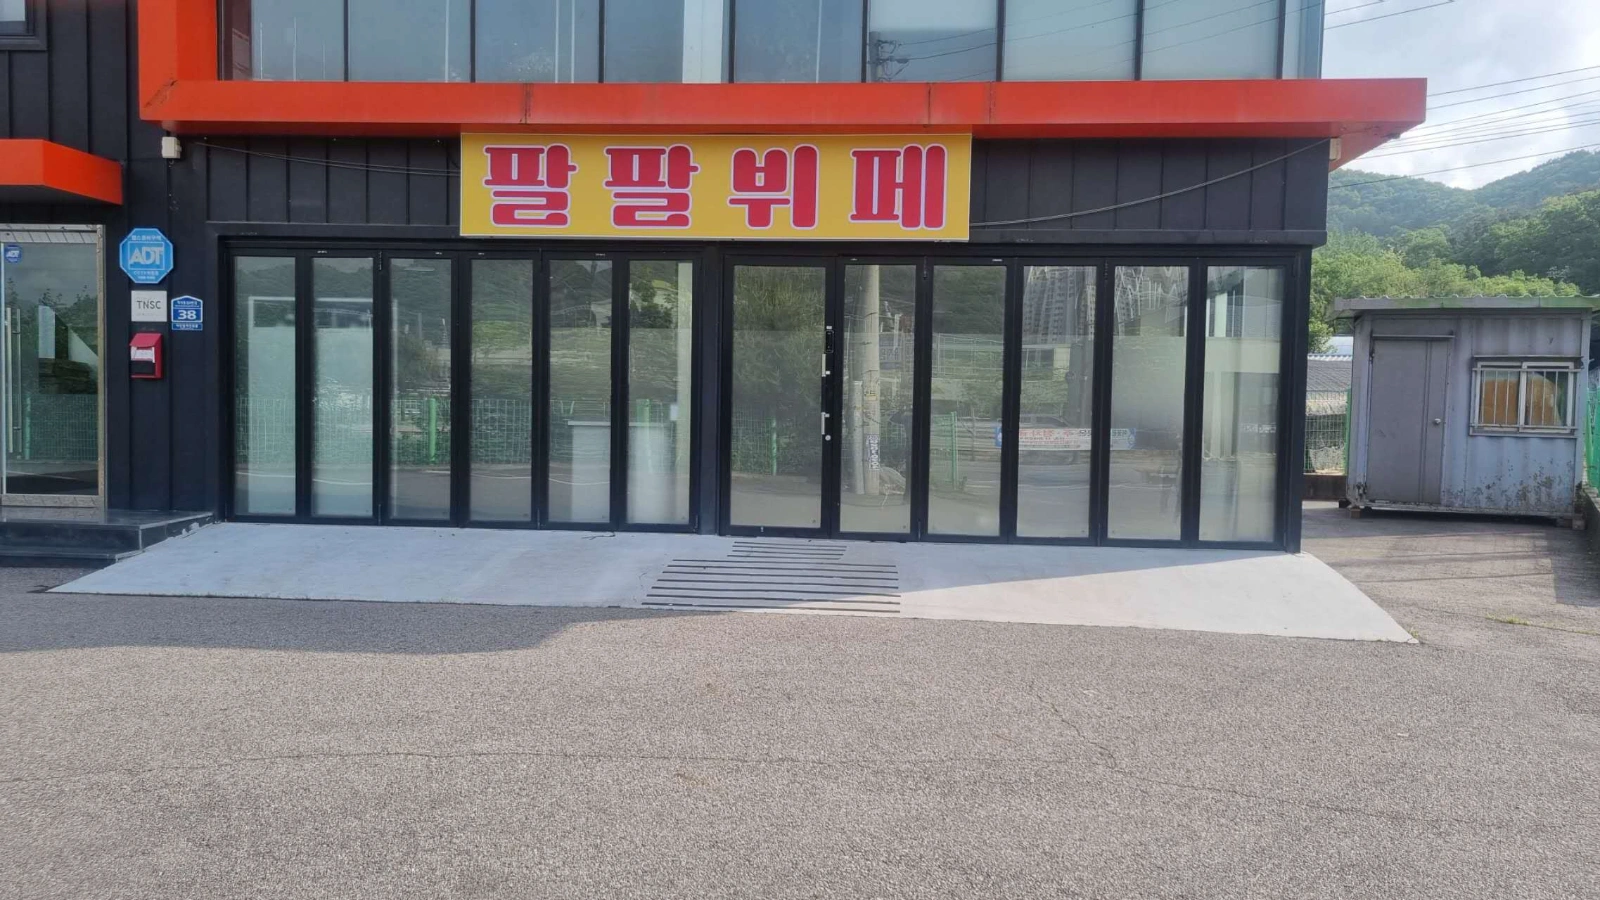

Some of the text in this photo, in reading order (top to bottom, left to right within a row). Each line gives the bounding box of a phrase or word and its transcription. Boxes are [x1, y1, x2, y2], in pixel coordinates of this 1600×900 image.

[129, 246, 164, 265] ADT
[136, 300, 162, 310] TNSC
[177, 309, 197, 320] 38
